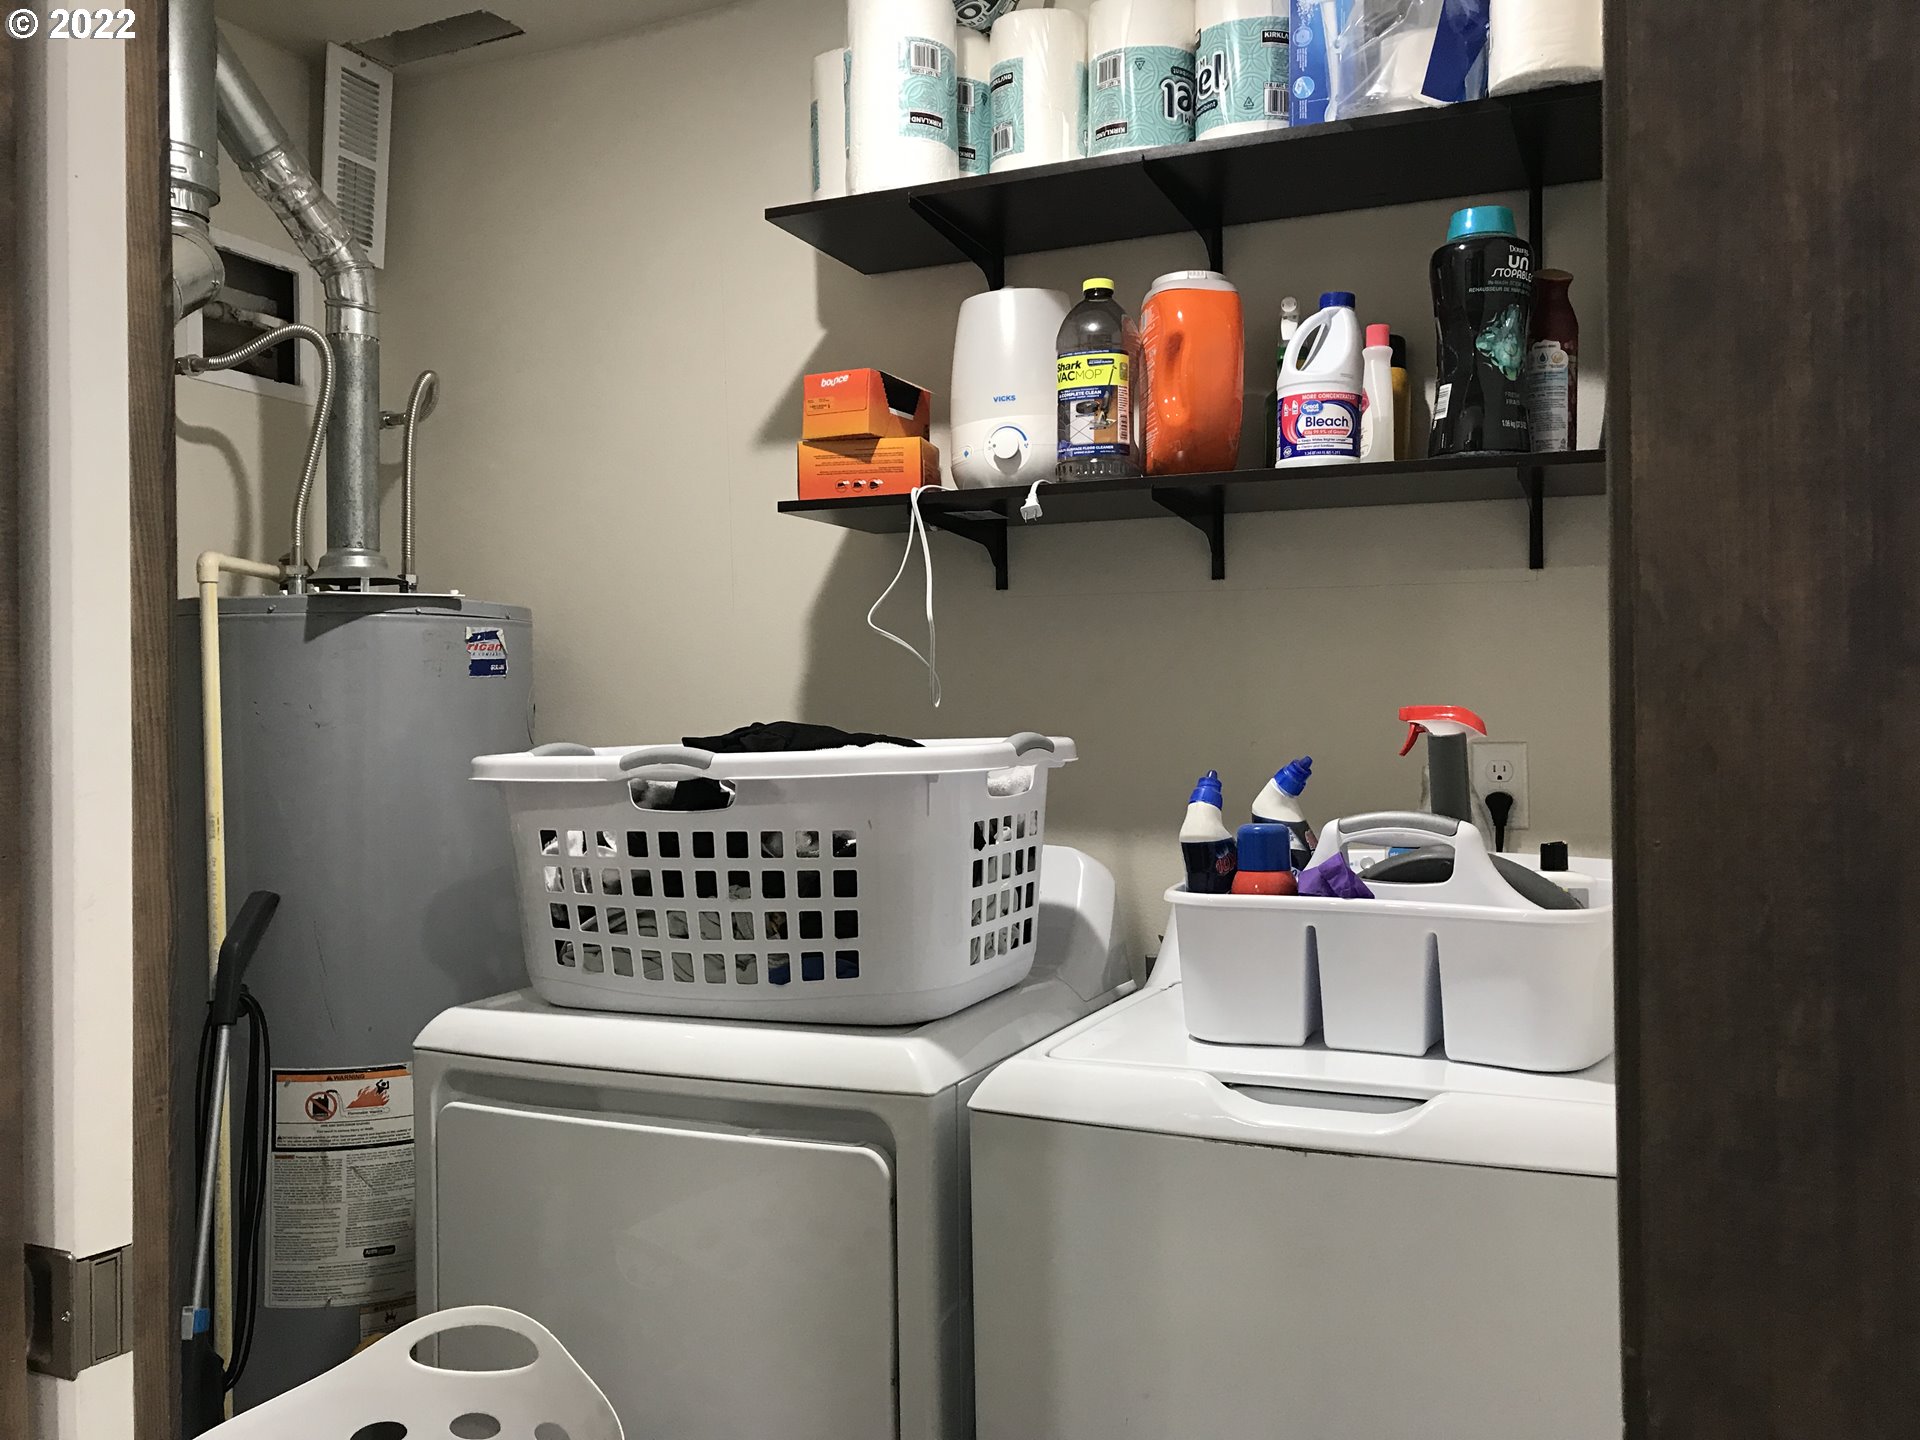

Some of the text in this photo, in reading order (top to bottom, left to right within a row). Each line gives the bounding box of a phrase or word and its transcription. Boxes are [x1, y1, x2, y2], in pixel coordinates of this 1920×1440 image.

[1264, 31, 1288, 39] KIRKLA
[911, 115, 942, 128] KIRKLAND
[1096, 126, 1126, 138] KIRKLAND
[1057, 360, 1081, 373] Shark
[821, 374, 849, 388] bounce
[1057, 368, 1103, 383] VACMOP
[993, 394, 1016, 403] VICKS
[1305, 416, 1349, 427] Bleach
[466, 643, 503, 652] rican
